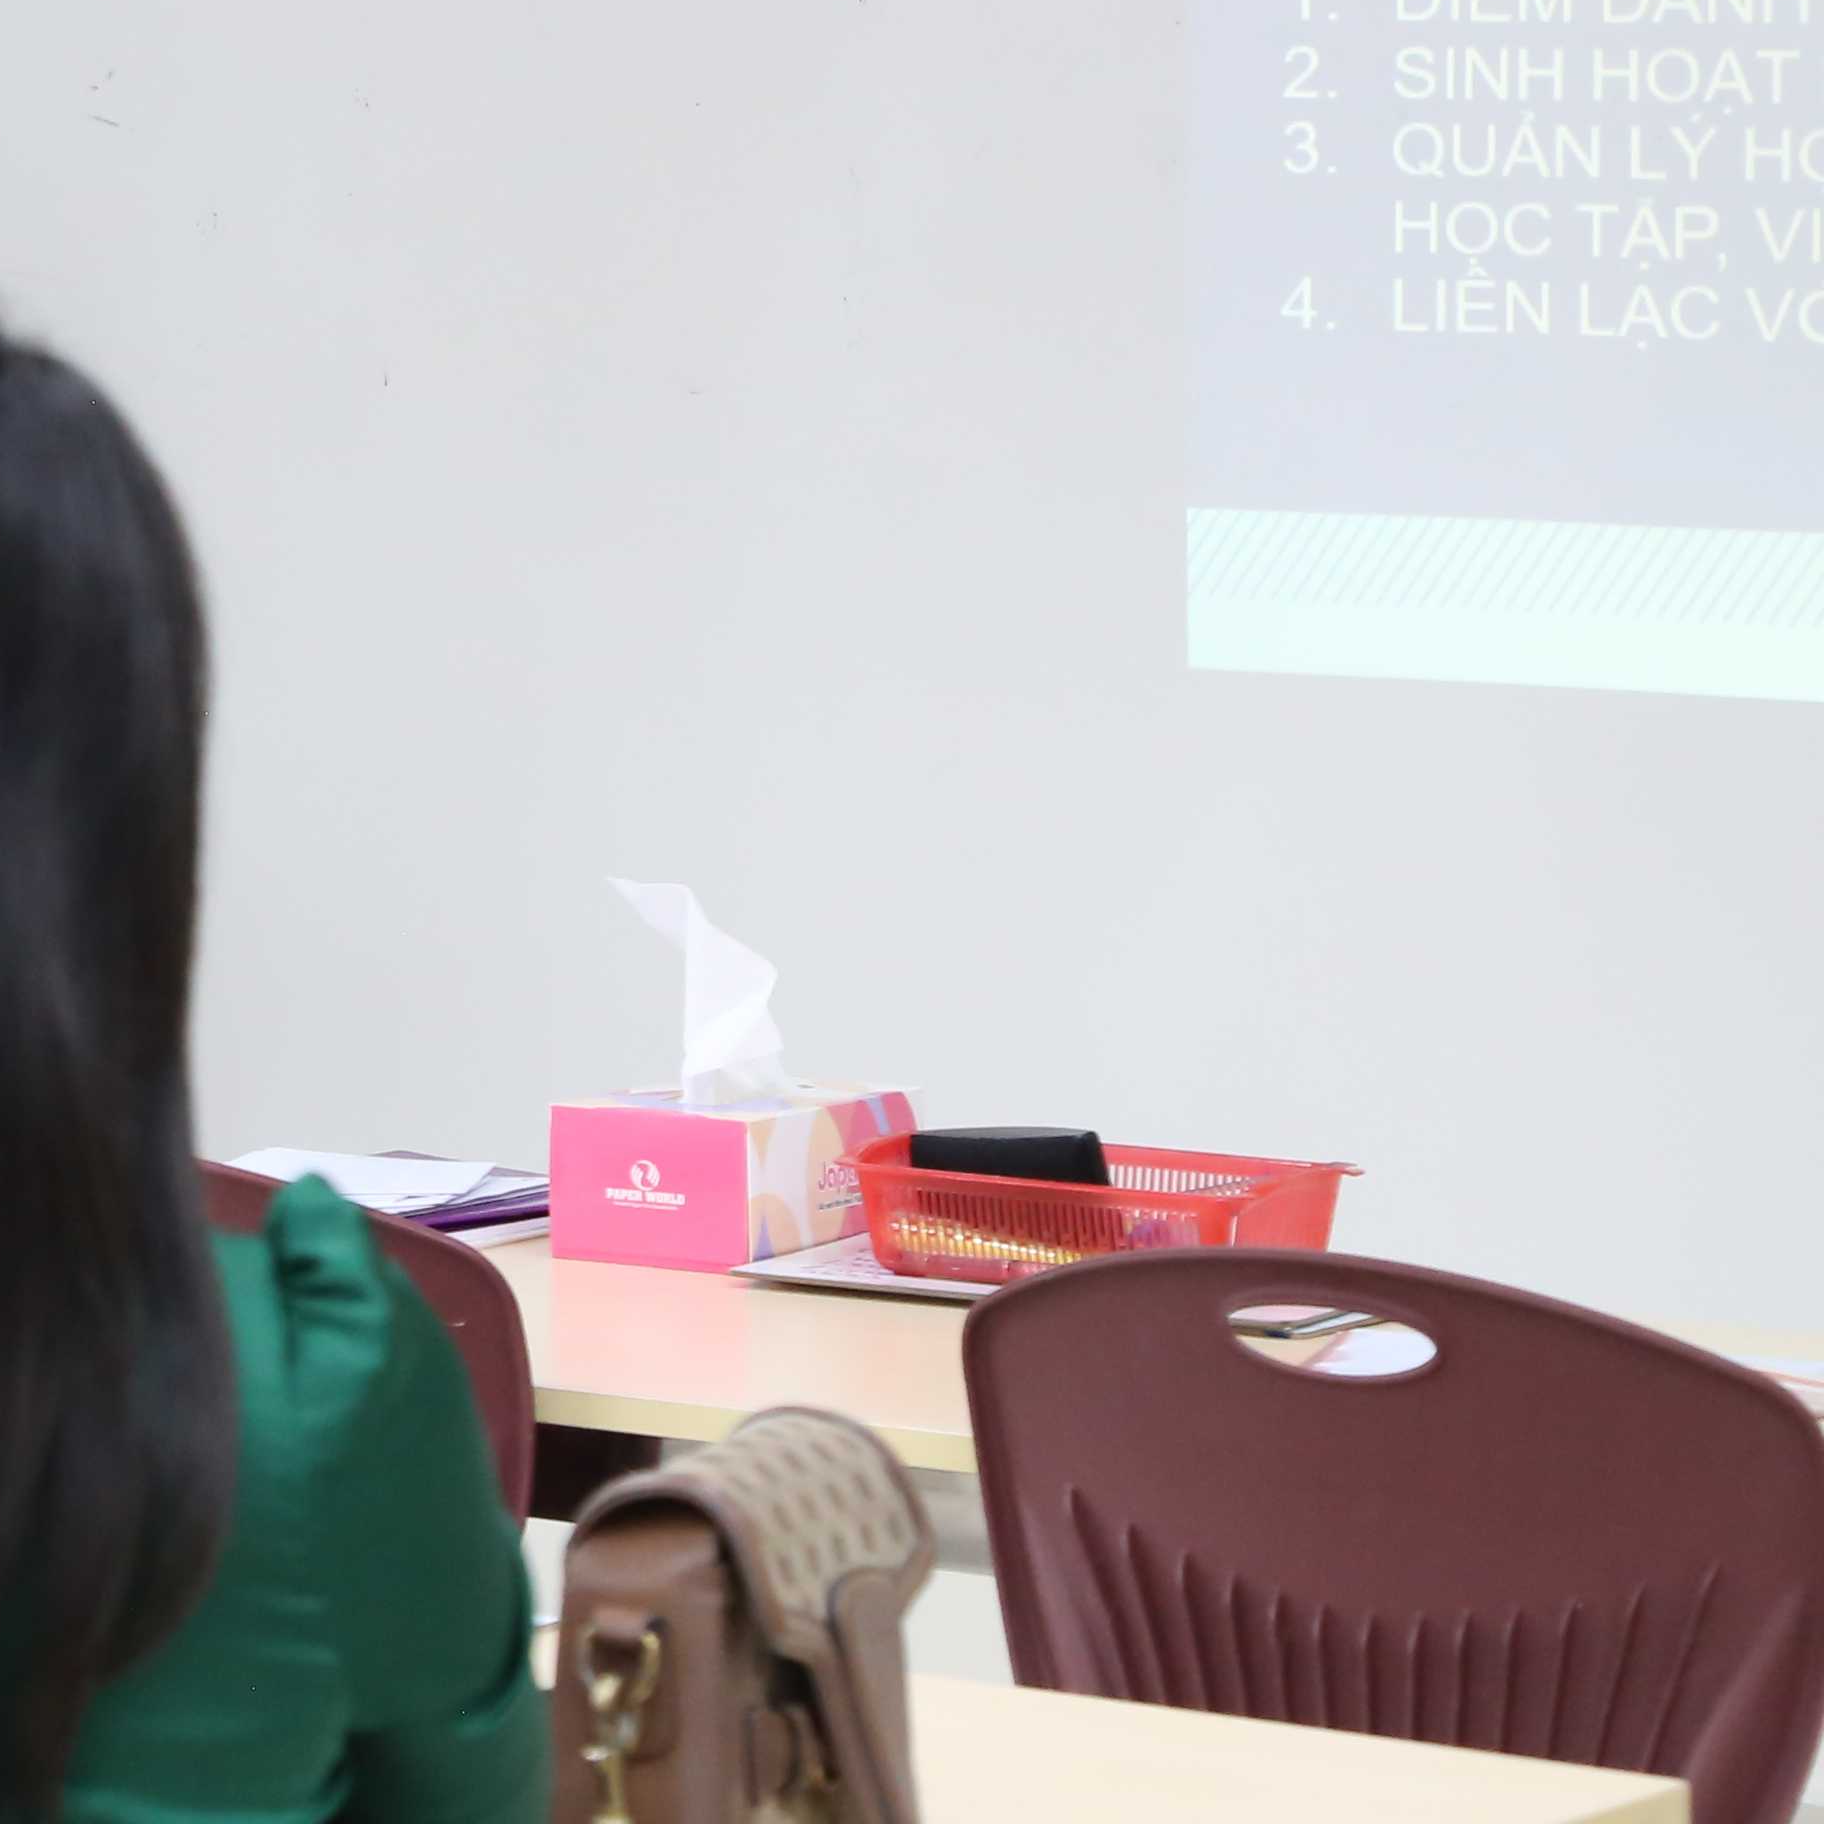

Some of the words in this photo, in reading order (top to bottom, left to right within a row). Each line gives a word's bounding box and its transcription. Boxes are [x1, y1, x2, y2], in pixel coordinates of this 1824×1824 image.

[1283, 46, 1340, 100] 2.
[1393, 45, 1564, 102] SINH
[1591, 47, 1801, 115] HOẠT
[1283, 121, 1340, 175] 3.
[1392, 110, 1601, 178] QUẢN
[1631, 113, 1717, 182] LÝ
[1393, 200, 1552, 268] HỌC
[1280, 276, 1337, 331] 4.
[1579, 281, 1722, 351] LẠC
